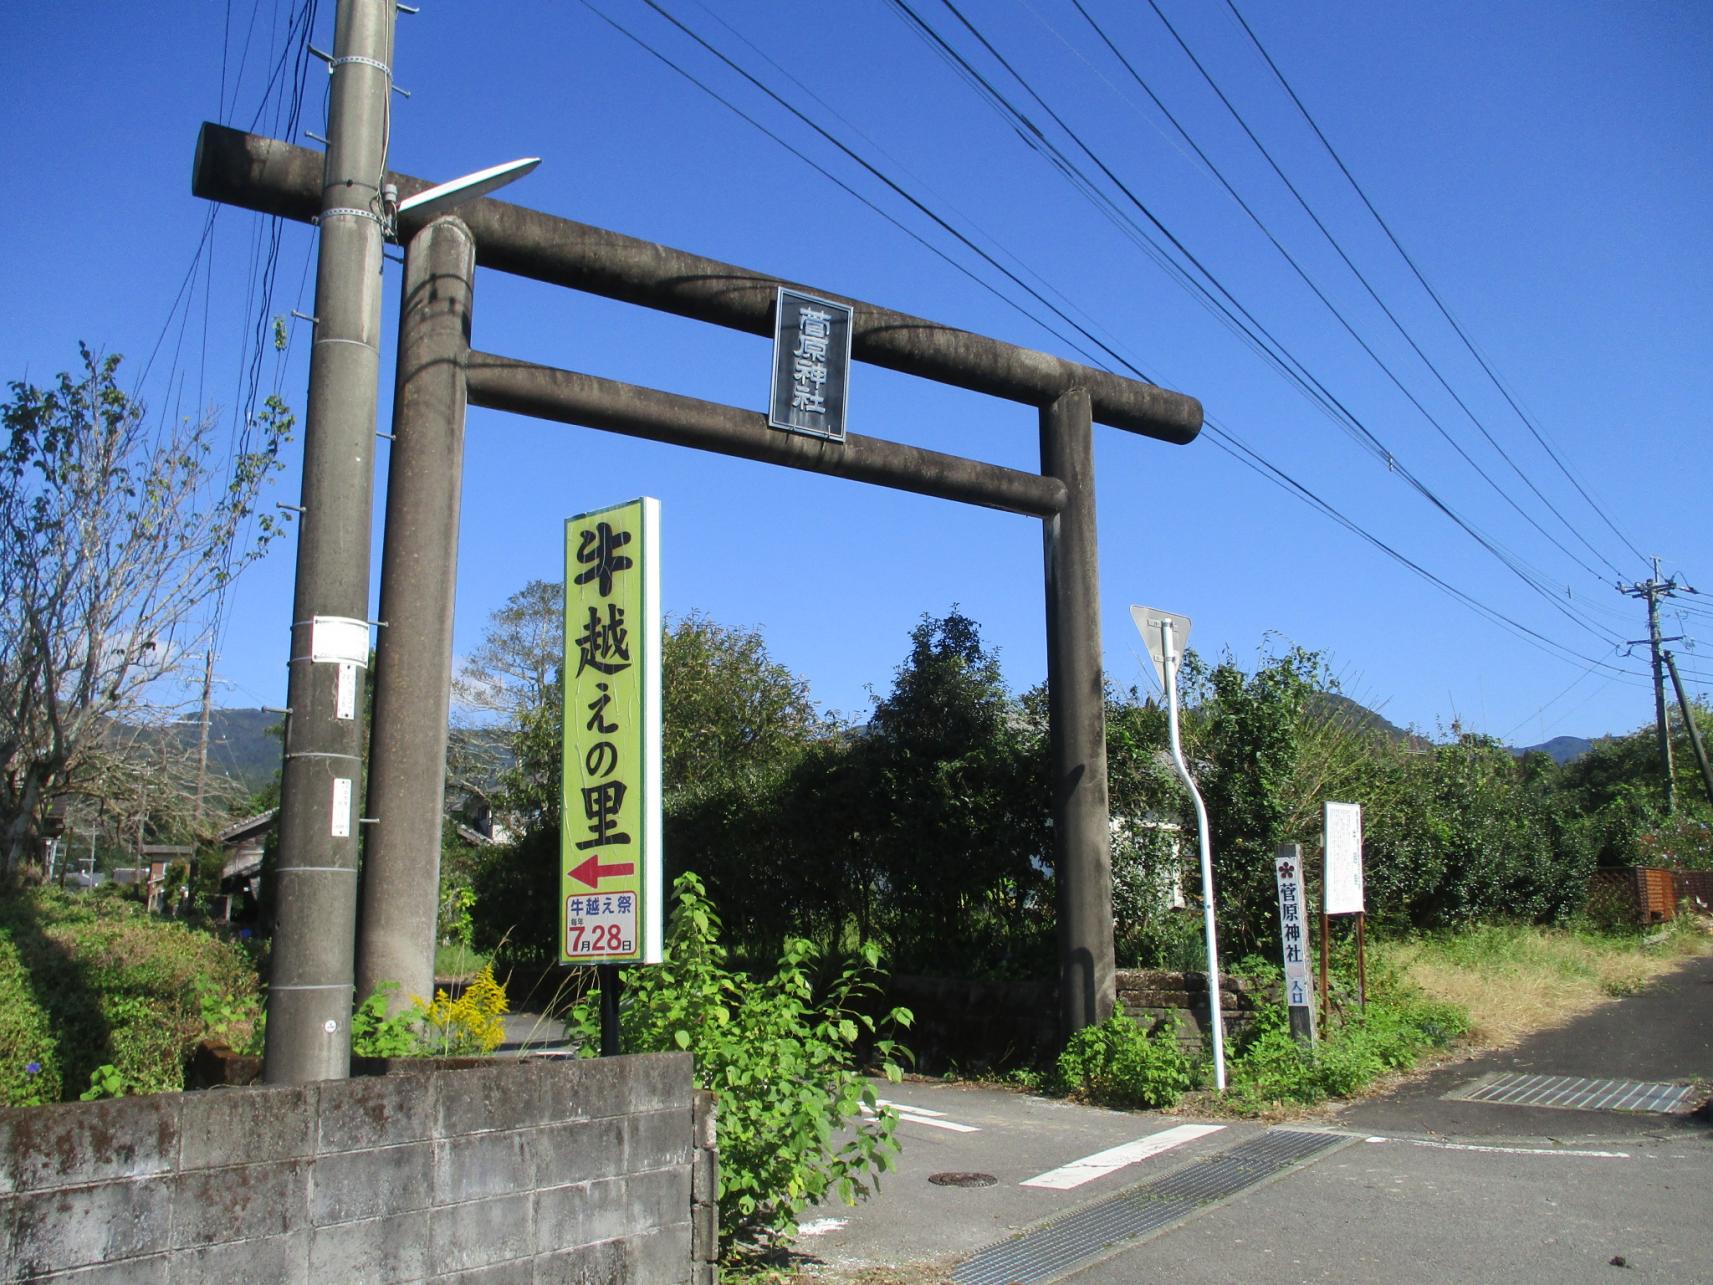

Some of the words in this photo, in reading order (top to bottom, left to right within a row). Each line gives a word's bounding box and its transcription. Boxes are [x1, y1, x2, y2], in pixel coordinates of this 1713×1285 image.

[793, 307, 831, 414] 菅原神社
[574, 521, 633, 850] 牛越えの里
[569, 925, 631, 952] 7月28日
[570, 896, 631, 916] 牛越え祭
[1280, 883, 1302, 962] 菅原神社
[1292, 980, 1303, 1003] 入口
